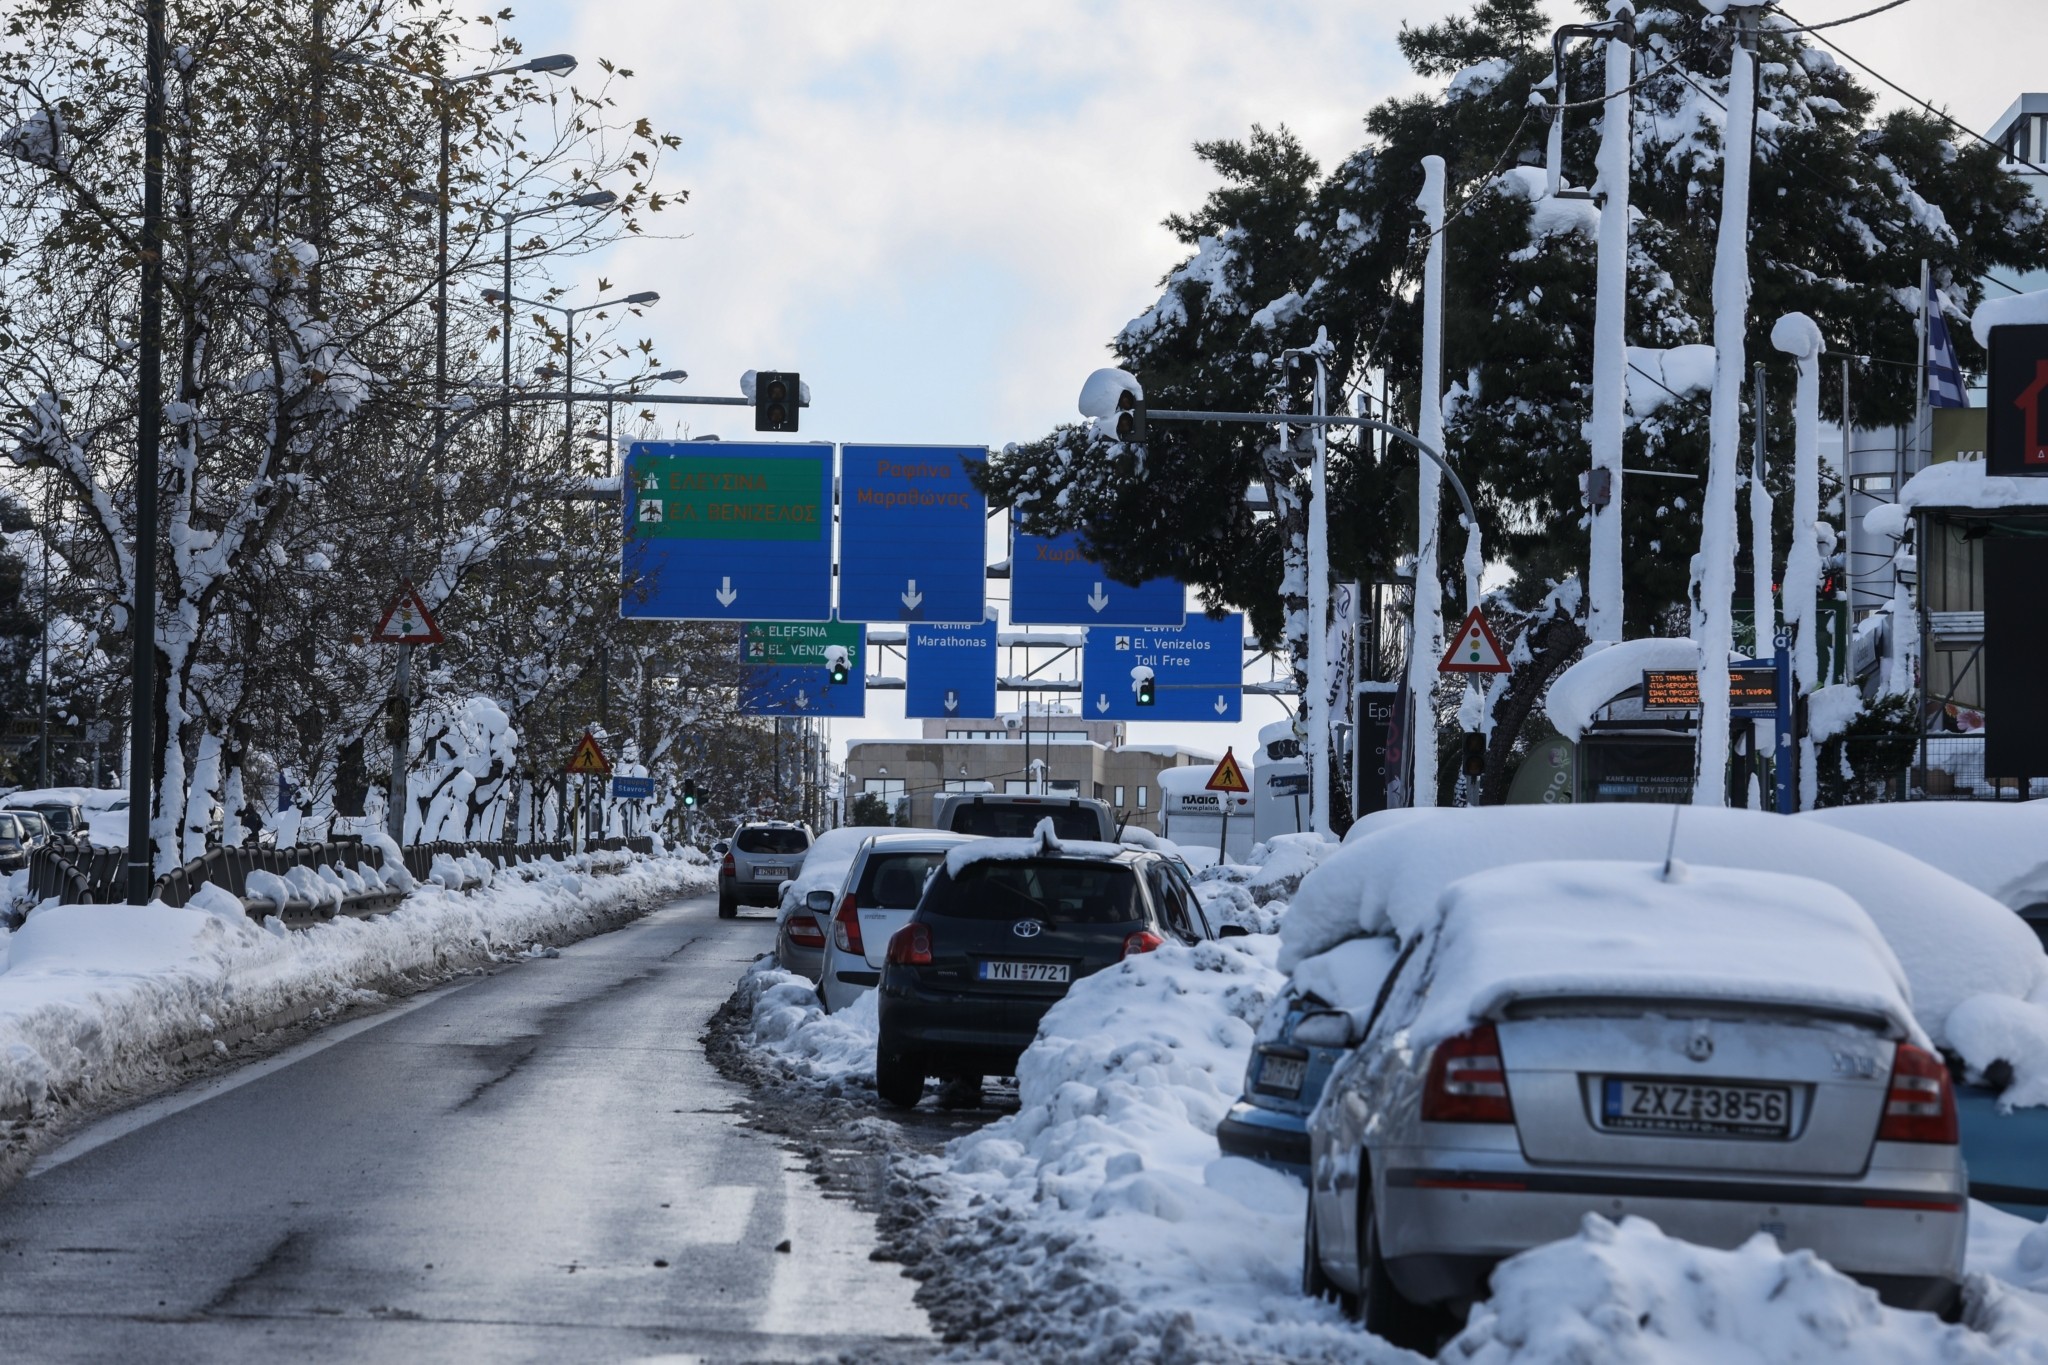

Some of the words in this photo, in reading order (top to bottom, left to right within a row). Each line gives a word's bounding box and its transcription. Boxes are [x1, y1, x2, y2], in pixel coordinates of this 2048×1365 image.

[878, 460, 951, 480] Ραφήνα
[669, 472, 768, 491] ΕΛΕΥΣΙΝΑ
[857, 488, 970, 509] Μαραθώνας
[708, 503, 816, 522] ΒΕΝΙΖΕΛΟΣ
[768, 626, 828, 637] ELEFSINA
[917, 635, 987, 647] Marathonas
[1134, 638, 1149, 649] El.
[1154, 638, 1211, 650] Venizelos
[768, 644, 786, 655] EL.
[791, 645, 856, 656] VENIZS
[1135, 655, 1158, 666] Toll
[1162, 655, 1190, 666] Free
[617, 784, 647, 793] Stavros
